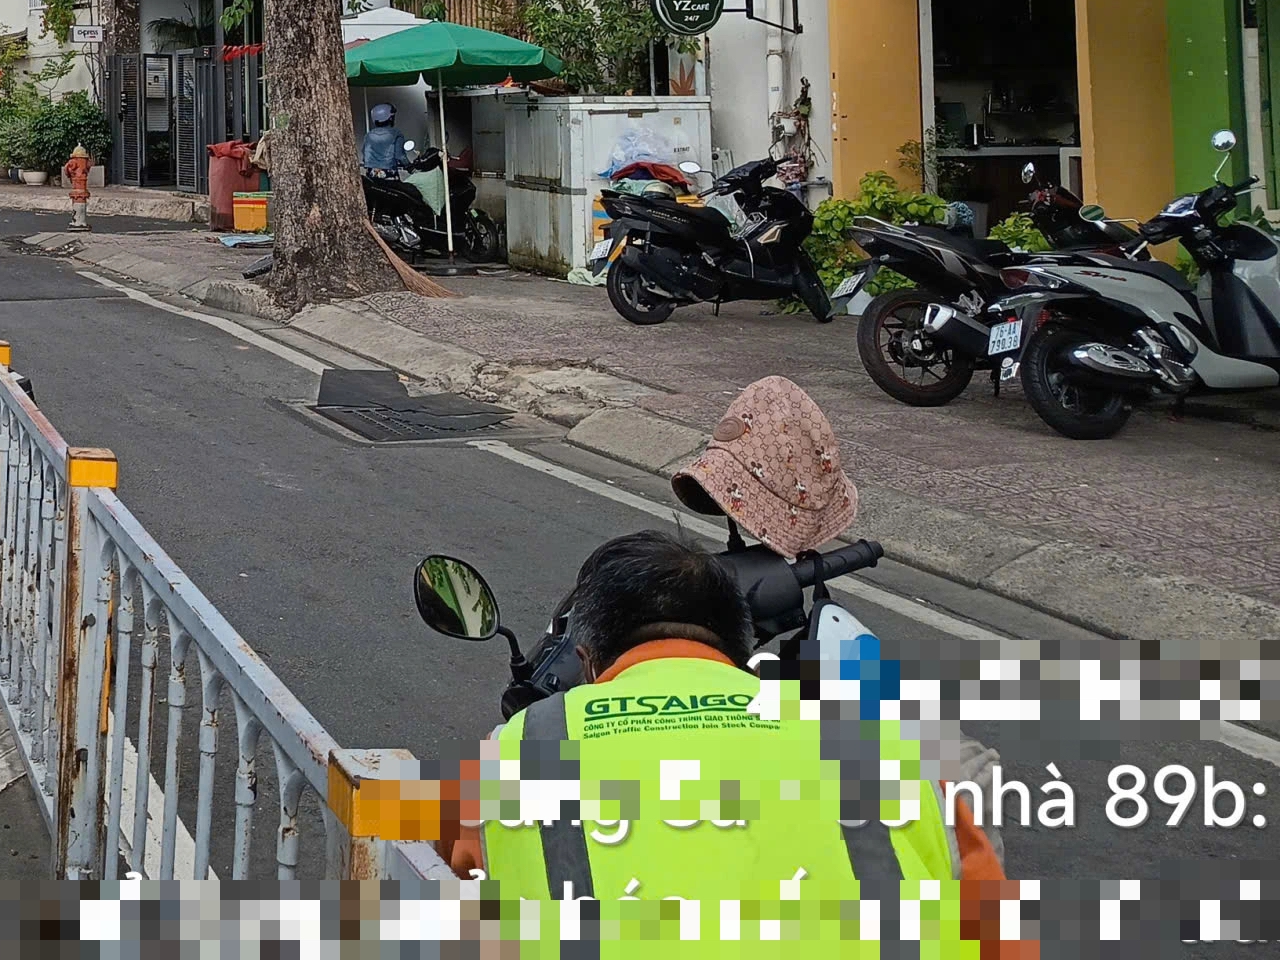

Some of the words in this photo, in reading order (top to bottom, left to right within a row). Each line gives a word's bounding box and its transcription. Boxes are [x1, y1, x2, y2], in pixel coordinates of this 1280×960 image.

[672, 0, 691, 11] YZ
[584, 694, 756, 717] GTSAIGO
[583, 731, 611, 740] Saigon
[613, 726, 641, 735] Traffic
[644, 723, 699, 732] Construction
[721, 721, 747, 729] Stock
[606, 720, 616, 728] TY
